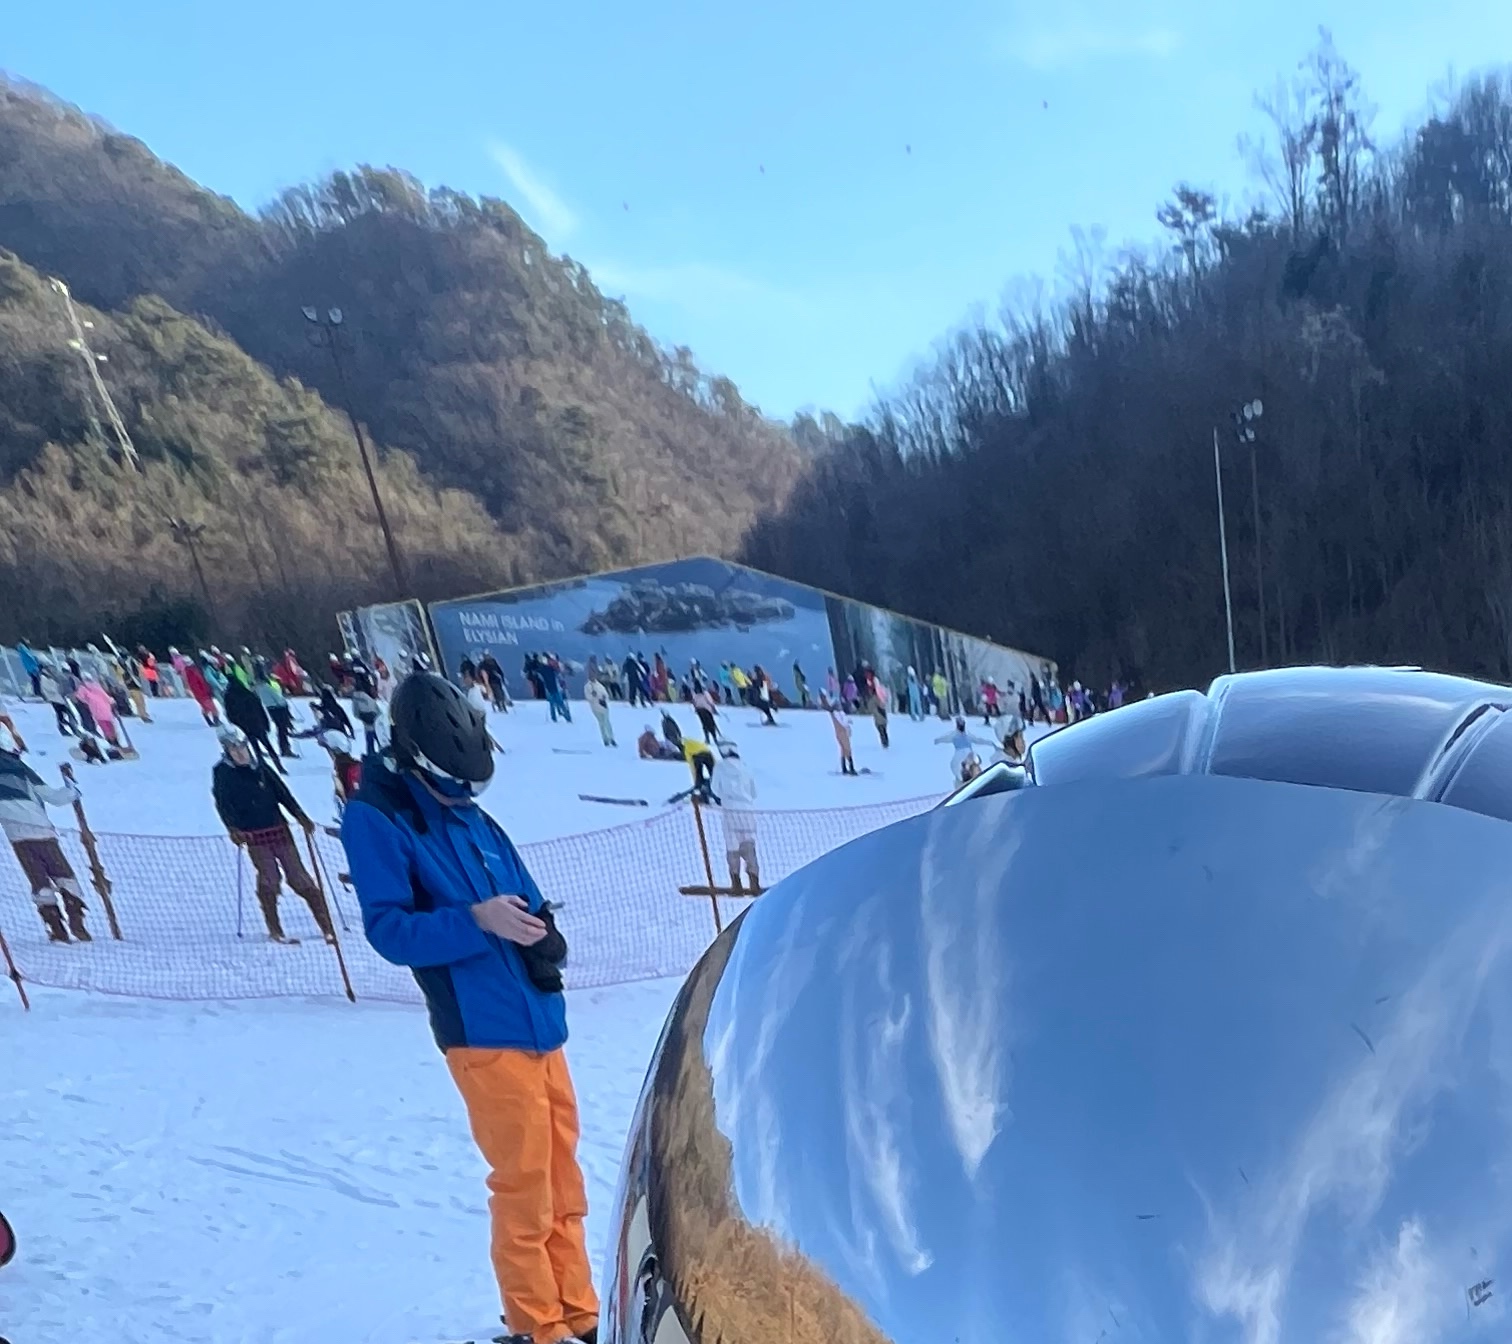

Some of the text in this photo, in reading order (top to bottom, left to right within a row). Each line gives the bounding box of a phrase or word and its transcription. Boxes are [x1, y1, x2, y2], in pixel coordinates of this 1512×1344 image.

[459, 611, 499, 628] NAMI
[500, 614, 549, 632] ISLAND
[463, 627, 519, 645] ELYSIAN
